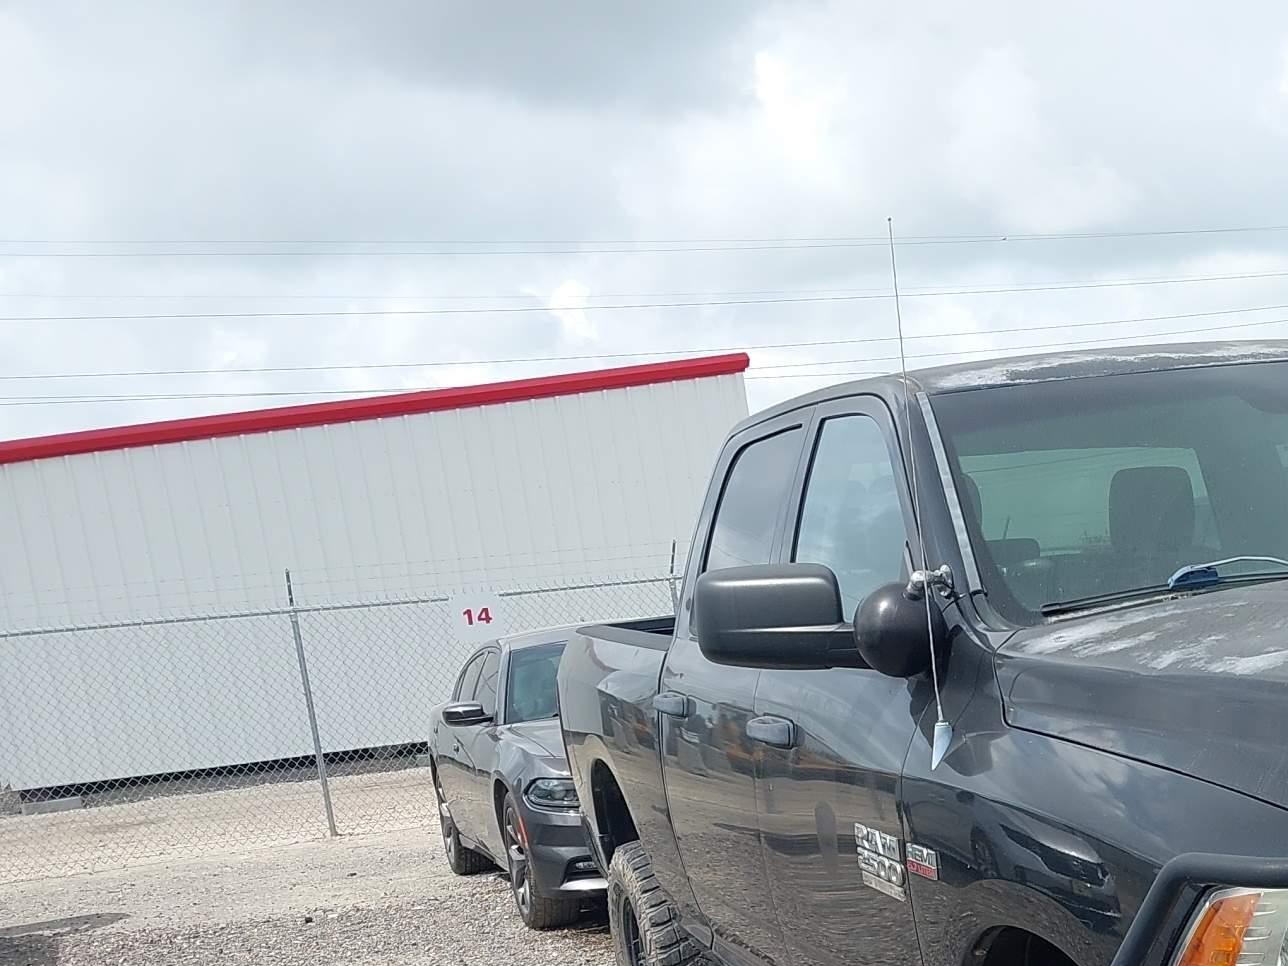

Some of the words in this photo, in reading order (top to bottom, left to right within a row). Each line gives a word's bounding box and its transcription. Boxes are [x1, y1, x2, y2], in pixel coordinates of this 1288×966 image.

[462, 607, 493, 626] 14
[854, 822, 900, 861] RAM
[906, 842, 937, 868] HEMI
[856, 846, 905, 887] 2500
